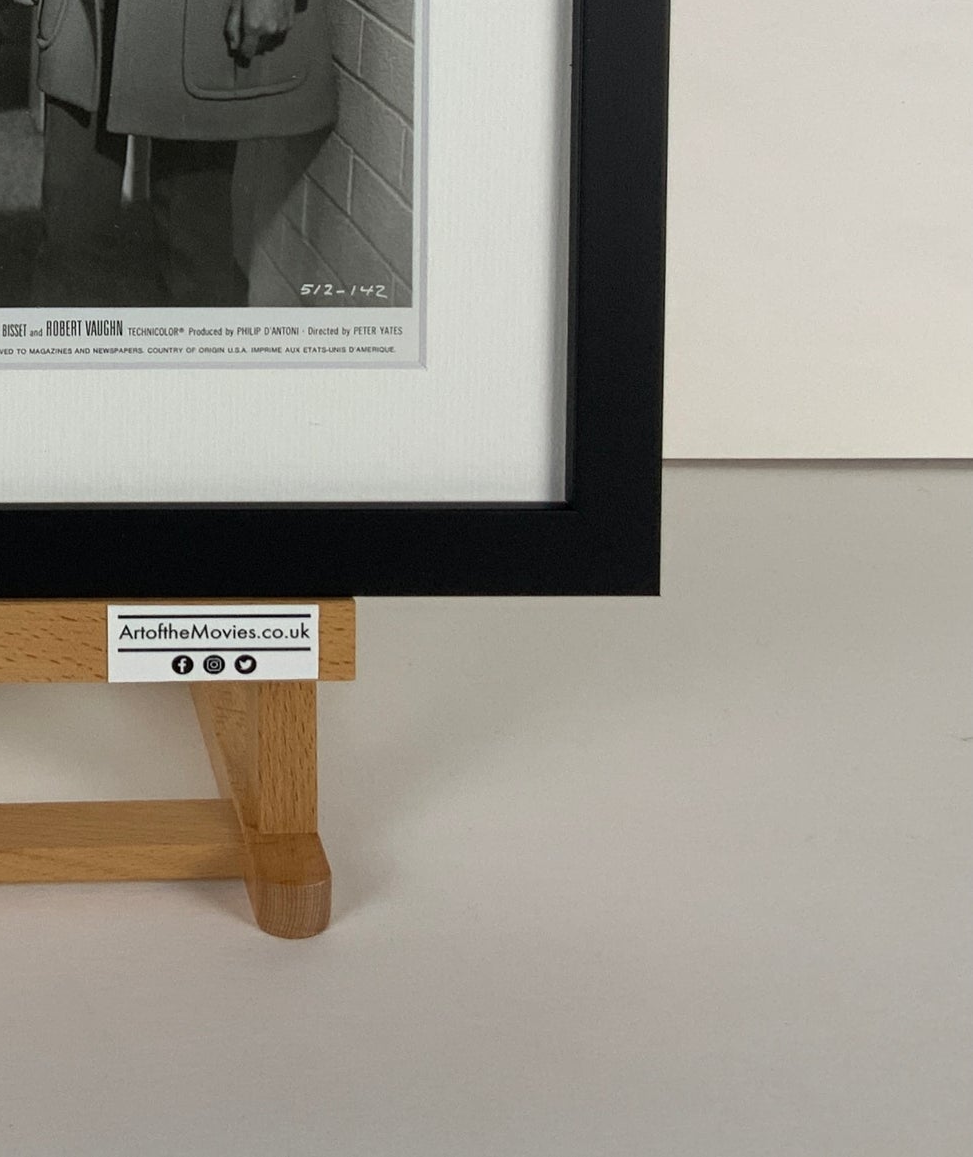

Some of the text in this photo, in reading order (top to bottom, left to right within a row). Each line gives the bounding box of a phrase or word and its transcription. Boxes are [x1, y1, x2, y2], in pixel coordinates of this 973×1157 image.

[300, 284, 388, 299] 512-142
[1, 324, 28, 337] BISSET
[29, 328, 44, 337] and
[45, 319, 83, 337] ROBERT
[84, 319, 124, 336] VAUGHN
[188, 327, 223, 336] Produced
[224, 328, 235, 337] by
[236, 327, 262, 336] PHILIP
[263, 326, 300, 336] D'ANTONI
[307, 327, 340, 335] Directed
[341, 327, 351, 337] by
[353, 326, 377, 335] PETER
[379, 326, 404, 335] YATES
[16, 347, 28, 356] TO
[28, 347, 73, 357] MAGAZINES
[74, 347, 91, 355] AND
[146, 346, 184, 355] COUNTRY
[185, 346, 196, 354] OF
[198, 346, 226, 354] ORIGIN
[284, 346, 301, 355] AUX
[119, 622, 310, 640] ArtoftheMovies.co.uk
